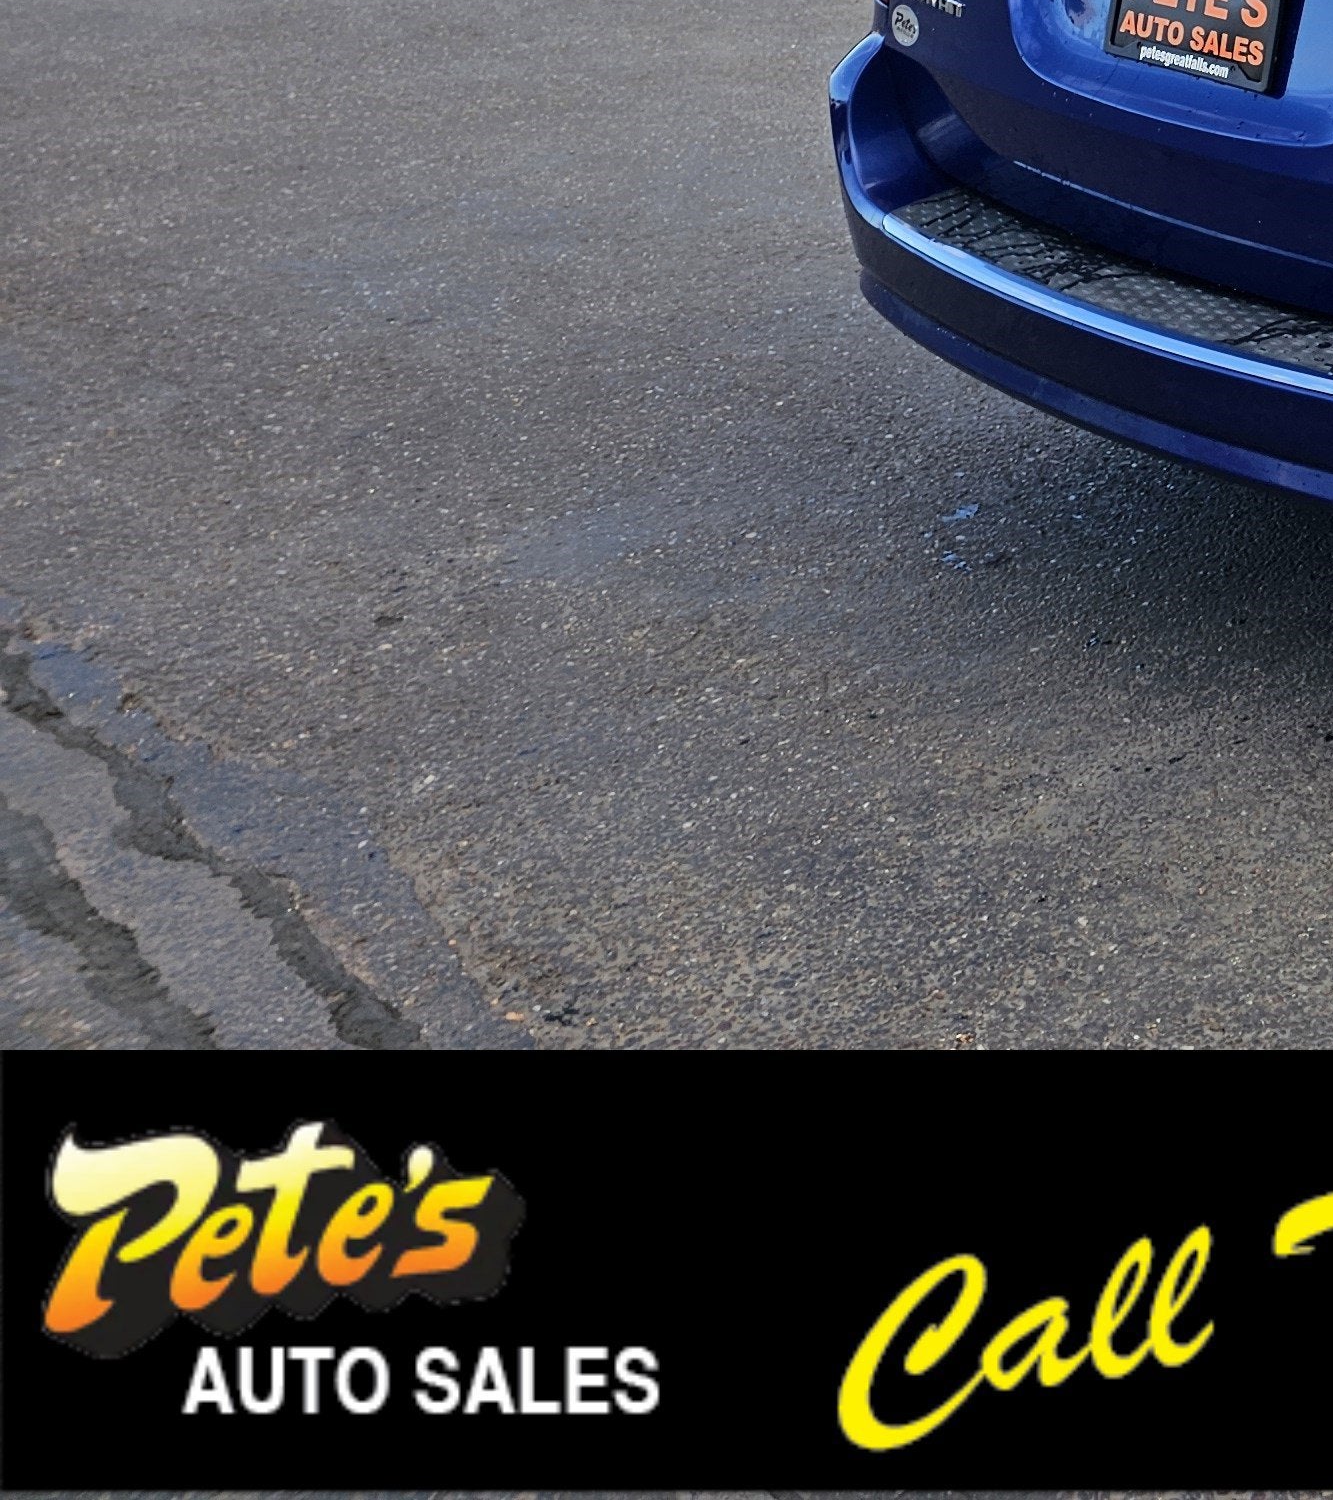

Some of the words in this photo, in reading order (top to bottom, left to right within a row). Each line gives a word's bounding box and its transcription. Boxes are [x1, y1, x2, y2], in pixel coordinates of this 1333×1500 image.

[1119, 10, 1185, 46] AUTO
[1189, 26, 1265, 66] SALES
[1139, 45, 1229, 79] petesgreatfalls.com
